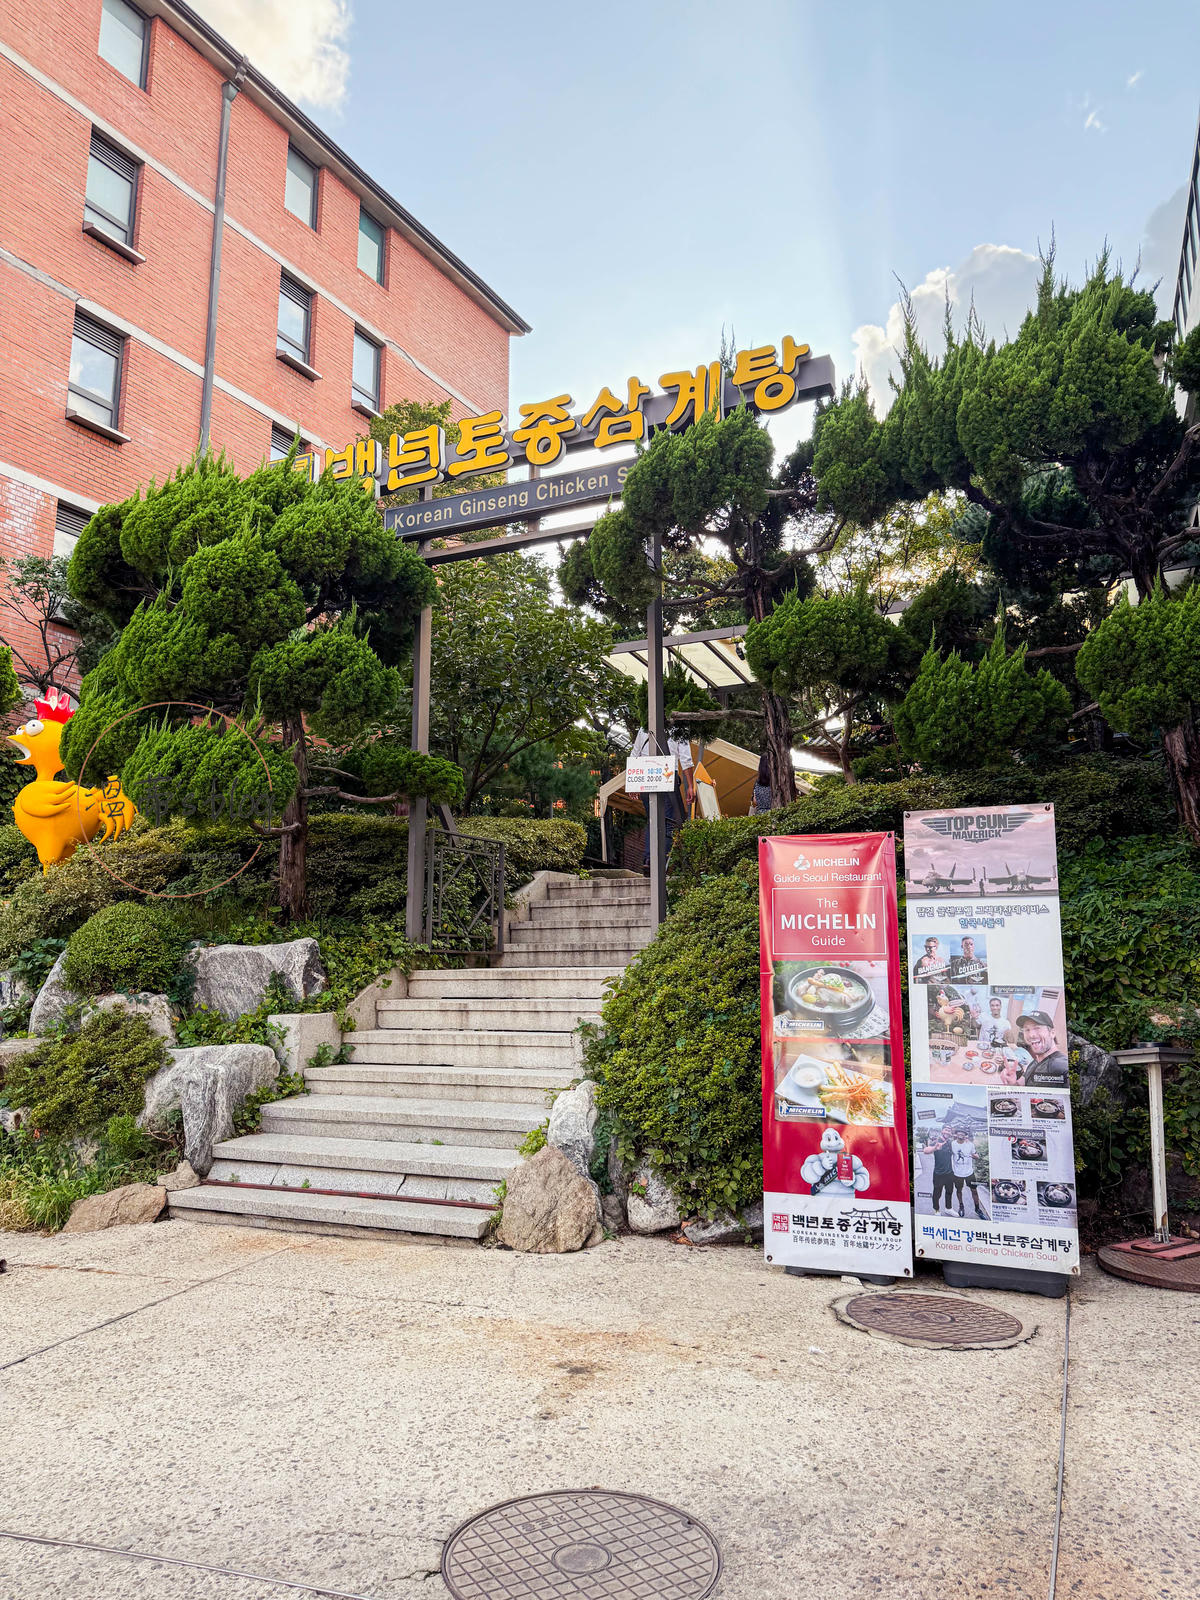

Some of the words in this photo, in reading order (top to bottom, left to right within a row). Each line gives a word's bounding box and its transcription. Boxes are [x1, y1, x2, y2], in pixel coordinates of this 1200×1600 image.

[324, 335, 811, 495] 백년토종삼계탕
[393, 506, 453, 529] Korean
[459, 489, 529, 516] Ginseng
[535, 472, 609, 501] Chicken
[627, 775, 645, 783] CLOSE
[946, 815, 975, 831] TOP
[976, 813, 1009, 830] GUN
[952, 829, 1002, 840] MAVERICK
[812, 857, 860, 868] MICHELIN
[773, 873, 801, 883] Guide
[802, 873, 829, 883] Seoul
[831, 872, 882, 882] Restaurant
[816, 897, 839, 909] The
[781, 913, 877, 930] MICHELIN
[958, 917, 1005, 929] 한국나들이
[811, 935, 846, 946] Guide
[958, 963, 979, 974] COYOTE
[788, 1021, 822, 1029] MICHELIN
[788, 1107, 824, 1115] MICHELIN
[792, 1213, 904, 1236] 백년토종삼계탕
[935, 1240, 963, 1251] Korean
[965, 1244, 999, 1256] Ginseng
[1000, 1247, 1034, 1259] Chicken
[1036, 1251, 1058, 1262] Soup
